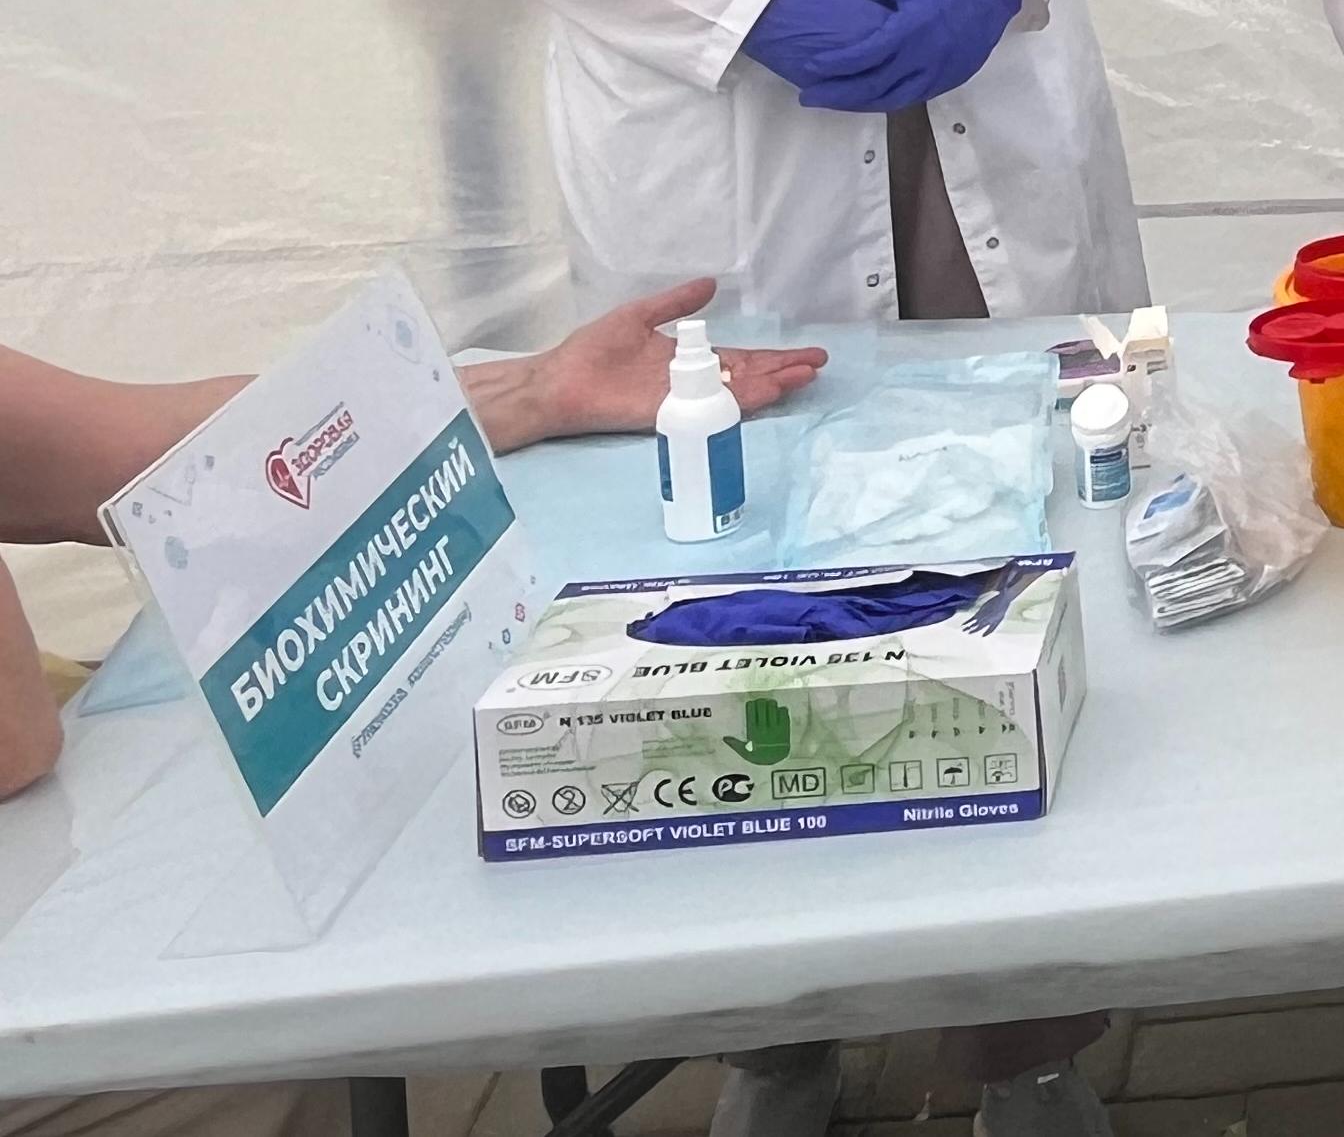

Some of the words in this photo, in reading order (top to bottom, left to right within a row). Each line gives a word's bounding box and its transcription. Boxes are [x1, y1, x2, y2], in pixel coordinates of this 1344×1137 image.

[230, 437, 475, 721] БИОХИМИЧЕСКИЙ
[315, 535, 453, 711] СКРИНИНГ
[718, 655, 817, 670] VIOLET
[883, 649, 905, 661] N
[530, 669, 601, 685] SFM
[632, 661, 708, 677] BLUE
[560, 716, 573, 727] N
[577, 715, 603, 726] 135
[609, 711, 666, 724] VIOLET
[671, 707, 712, 720] BLUE
[779, 773, 820, 793] MD
[903, 807, 955, 823] Nitrile
[959, 803, 1020, 819] Gloves
[505, 826, 664, 852] SFM-SUPERSOFT
[670, 822, 736, 841] VIOLET
[742, 819, 791, 834] BLUE
[798, 815, 827, 830] 100
